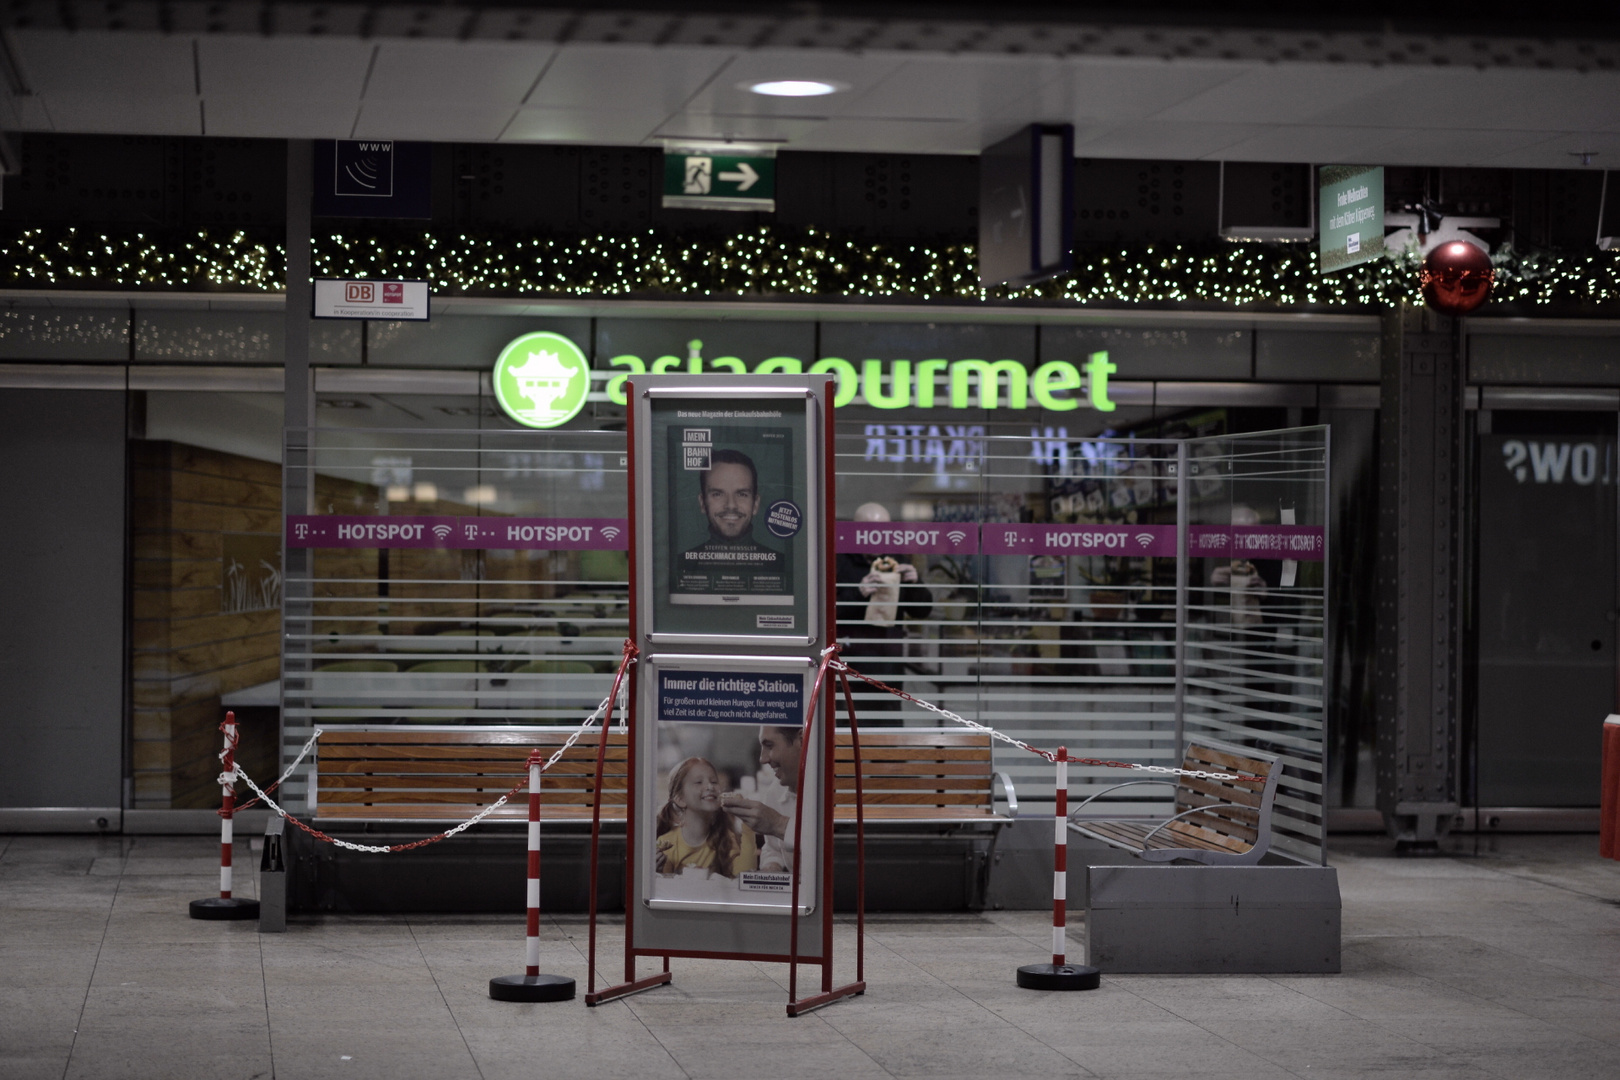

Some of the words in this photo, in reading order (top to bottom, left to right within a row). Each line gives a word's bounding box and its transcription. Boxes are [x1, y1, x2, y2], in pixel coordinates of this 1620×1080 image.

[349, 285, 371, 300] DB
[381, 310, 414, 318] cooperation
[702, 410, 724, 419] Magazin
[734, 410, 782, 418] Einkaufsbahnhöfe
[687, 432, 706, 442] MEIN
[687, 447, 708, 457] BAHN
[687, 457, 703, 467] HOF
[778, 506, 793, 514] JETZT
[770, 511, 798, 524] KOSTENLOS
[338, 524, 425, 540] HOTSPOT
[507, 525, 593, 542] HOTSPOT
[855, 530, 939, 545] HOTSPOT
[1045, 532, 1128, 548] HOTSPOT
[685, 552, 698, 560] DER
[699, 552, 736, 560] GESCHMACK
[737, 552, 749, 560] DES
[749, 553, 776, 561] ERFOLGS
[664, 677, 697, 690] Immer
[699, 678, 715, 691] die
[717, 678, 756, 695] richtige
[758, 679, 799, 693] Station.
[663, 696, 674, 705] Für
[674, 696, 696, 706] großen
[696, 697, 709, 706] und
[709, 697, 732, 706] kleinen
[732, 698, 756, 708] Hunger,
[756, 698, 765, 707] für
[766, 699, 785, 710] wenig
[785, 700, 798, 708] und
[663, 707, 675, 716] viel
[675, 708, 687, 716] Zeit
[696, 709, 707, 717] der
[707, 709, 719, 719] Zug
[720, 709, 735, 718] noch
[735, 710, 751, 718] nicht
[752, 711, 788, 720] abgefahren.
